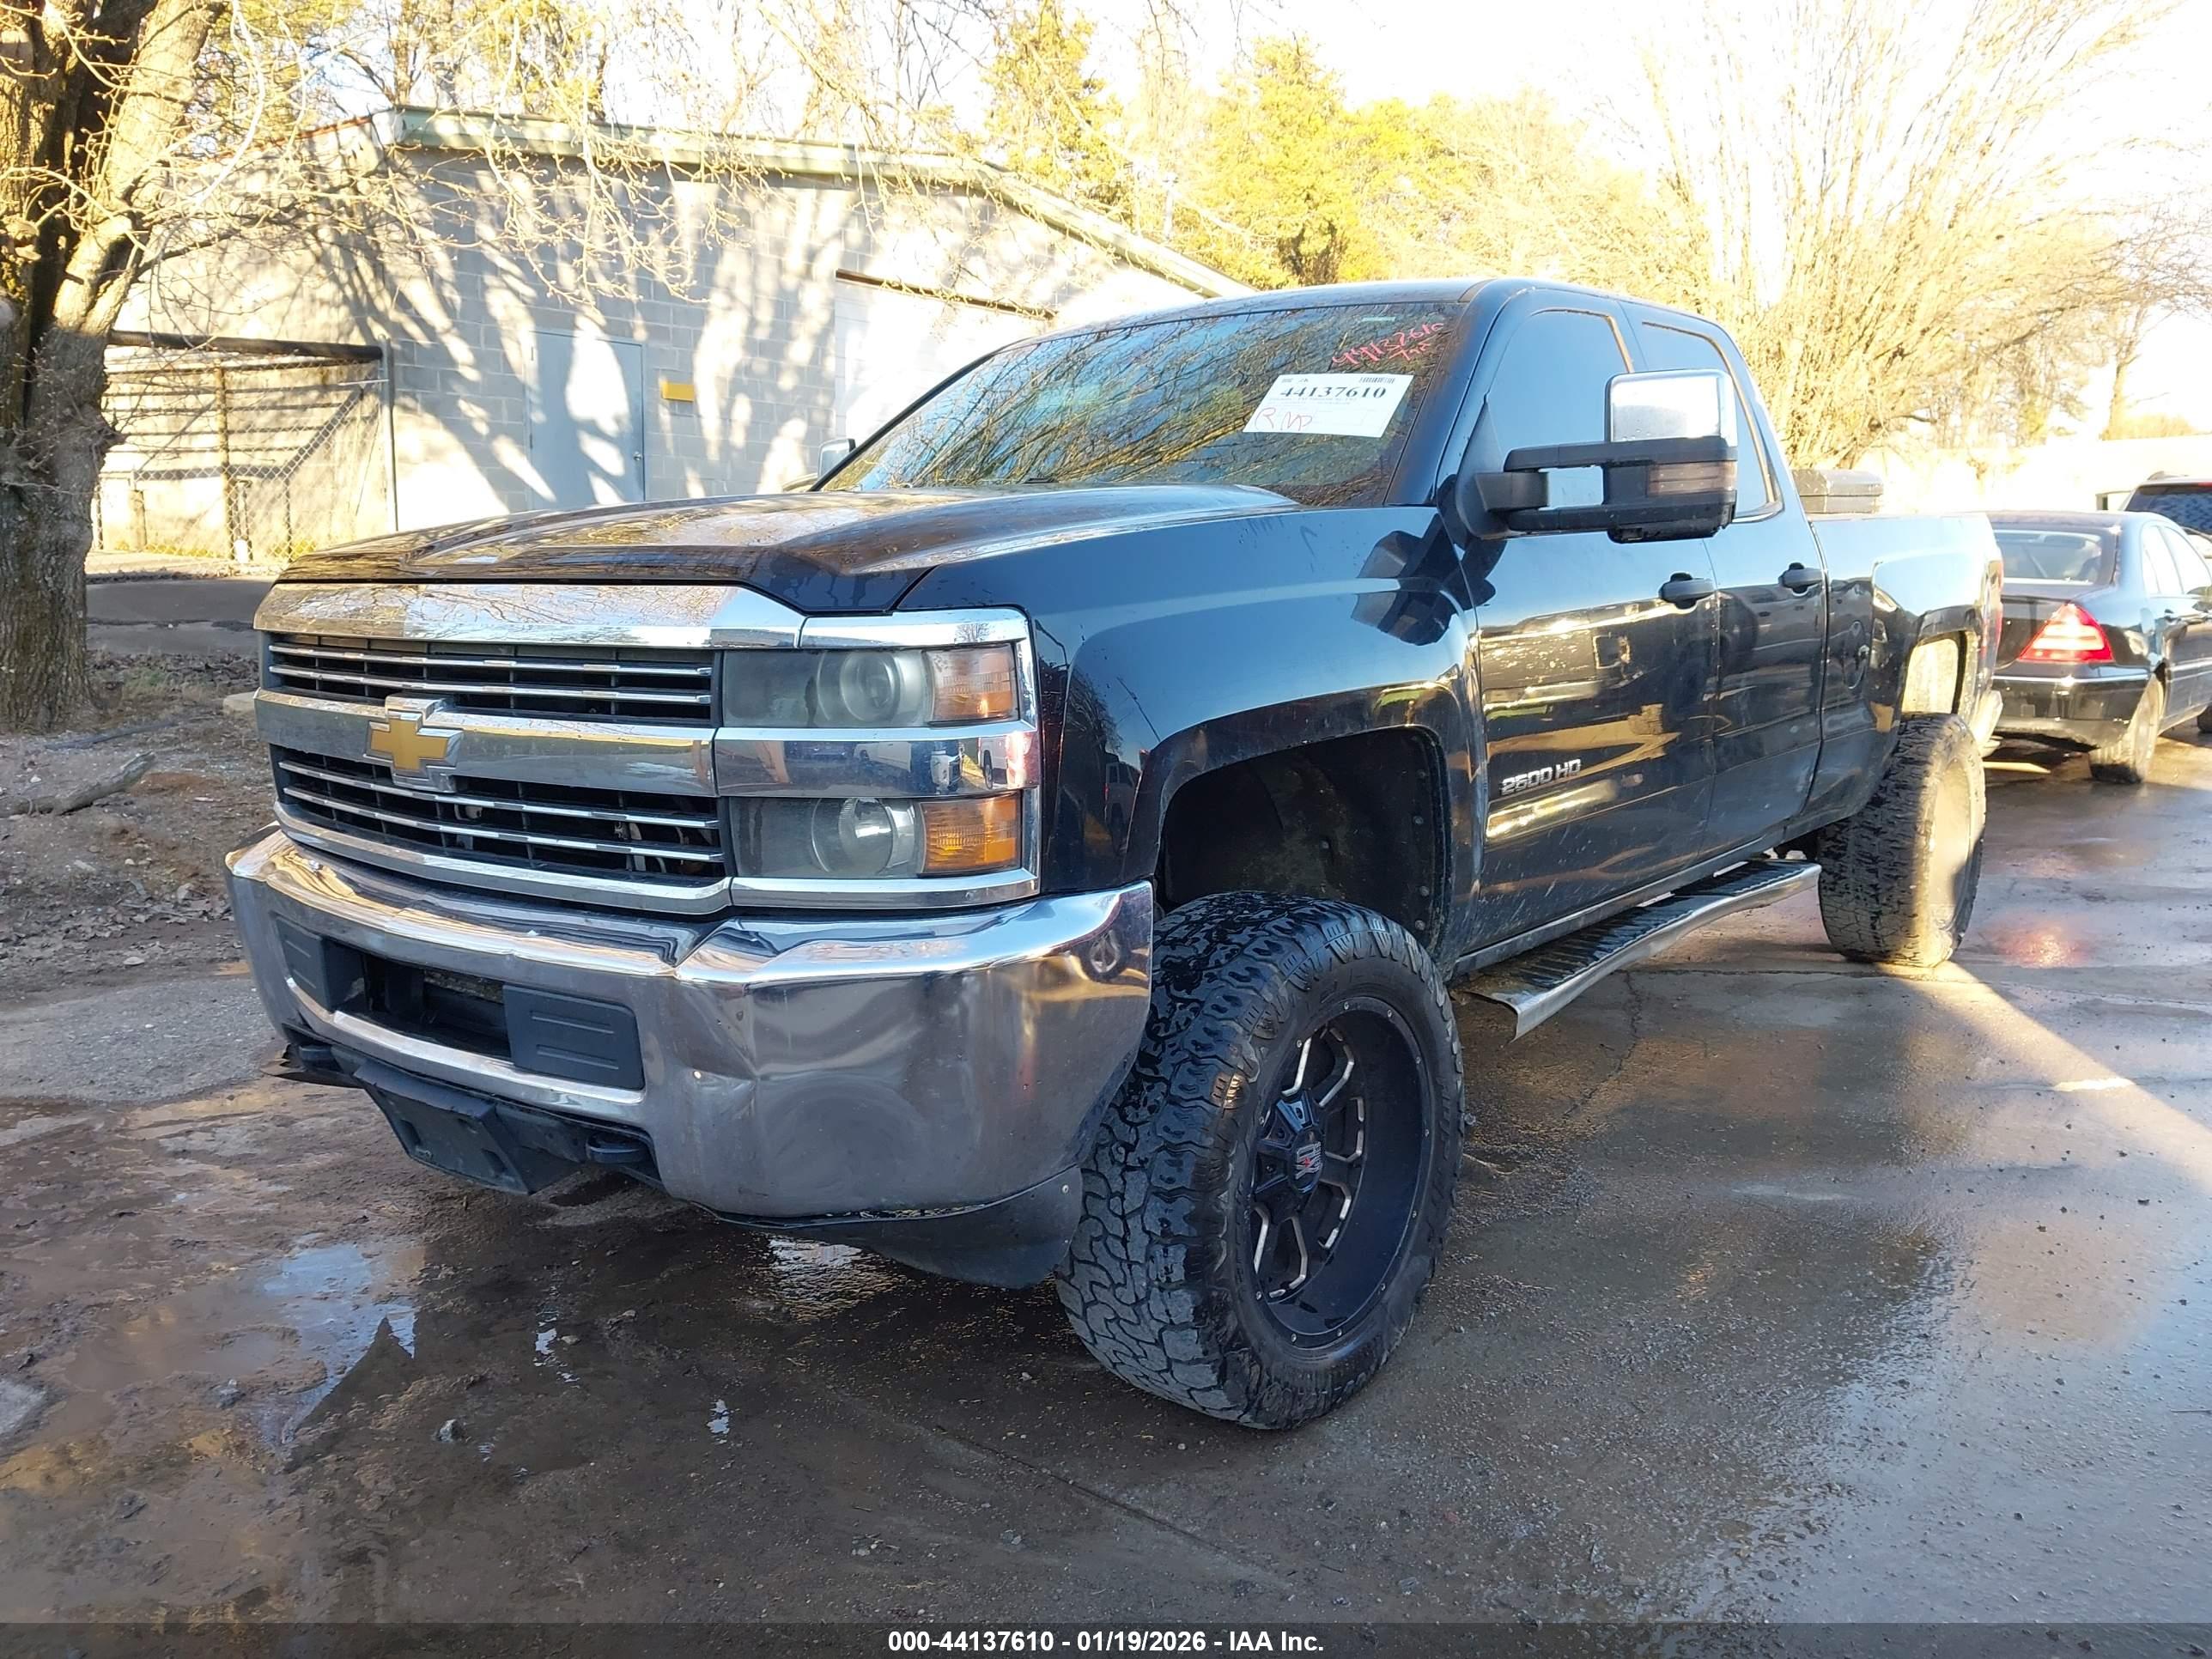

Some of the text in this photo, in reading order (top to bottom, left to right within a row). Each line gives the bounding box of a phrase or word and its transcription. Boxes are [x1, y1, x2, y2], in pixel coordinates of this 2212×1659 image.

[1280, 386, 1387, 399] 44137610
[1500, 758, 1582, 795] 2500 HD
